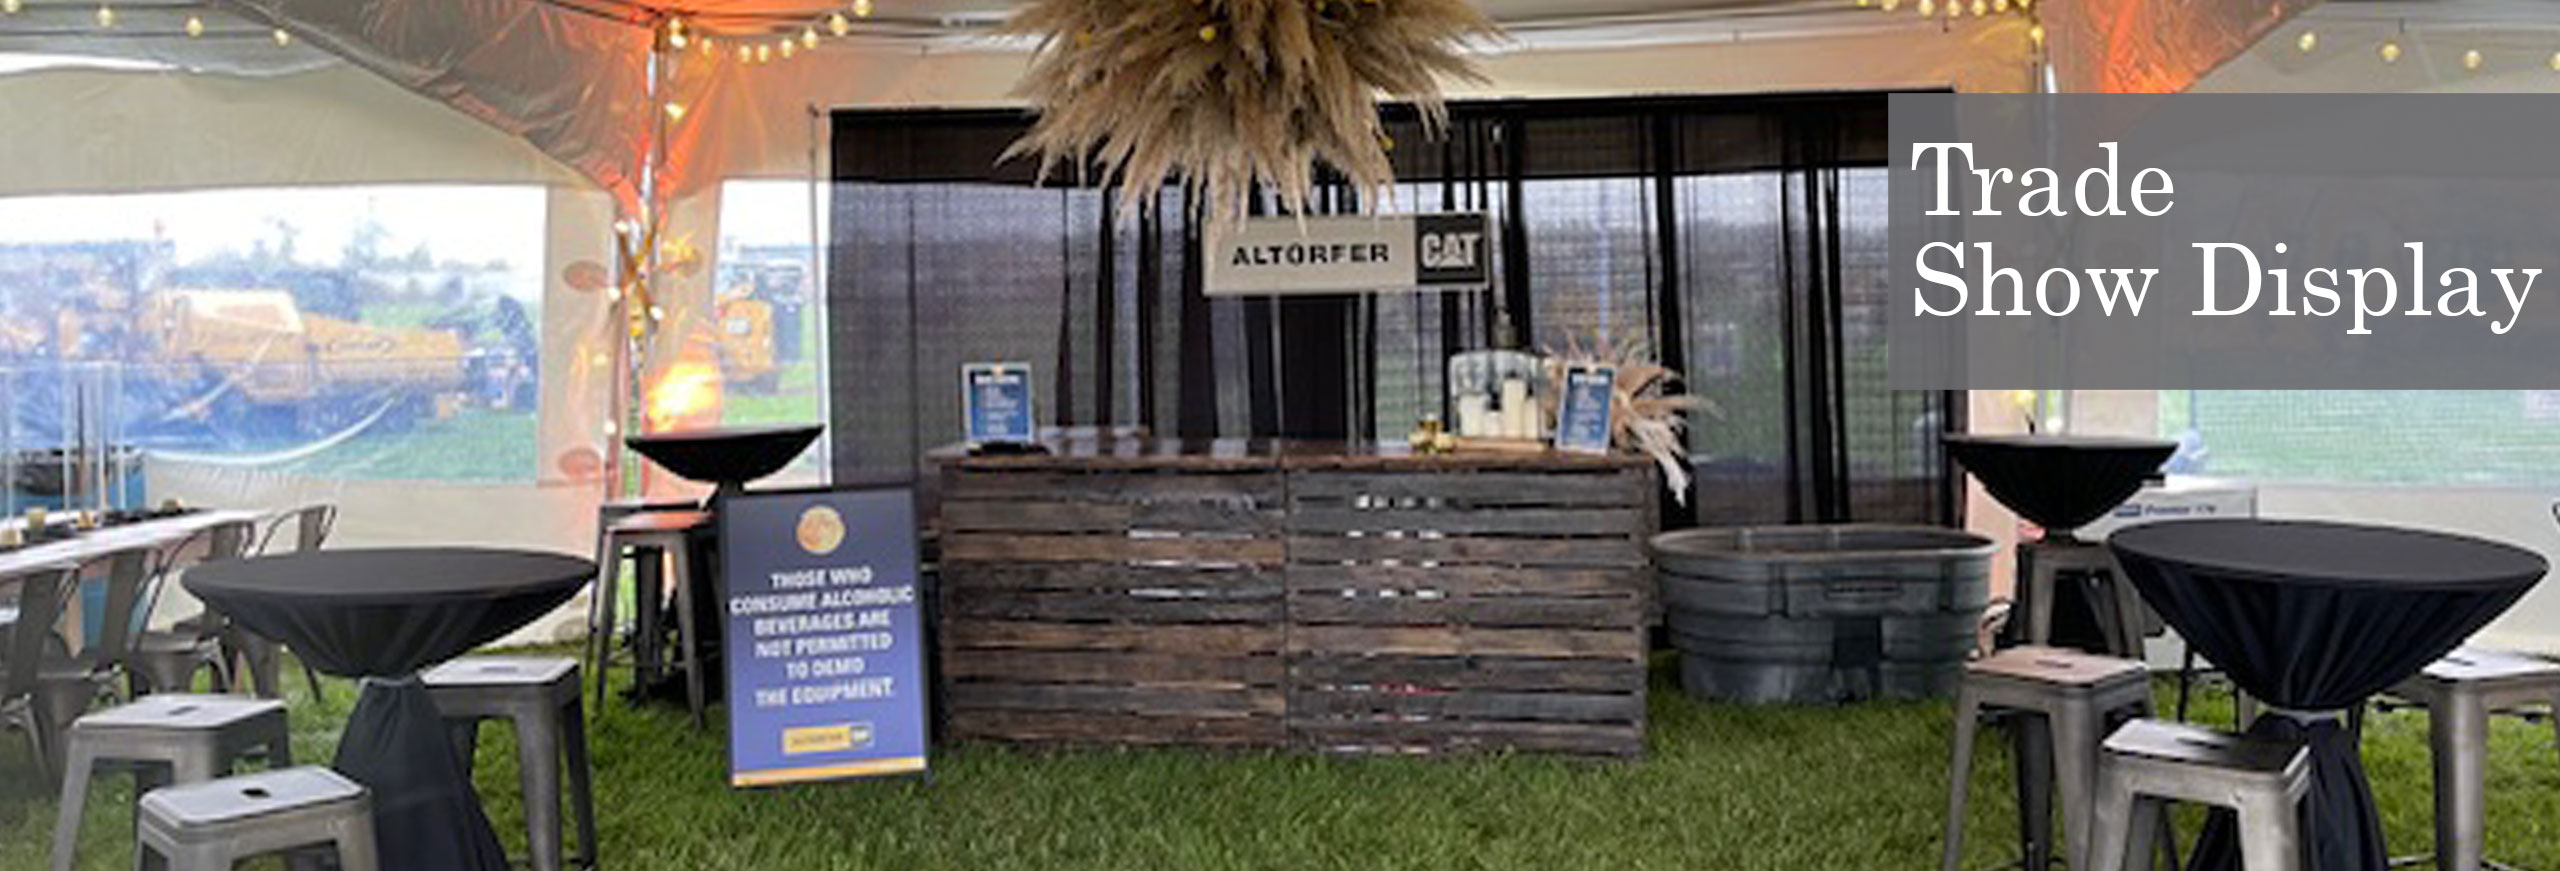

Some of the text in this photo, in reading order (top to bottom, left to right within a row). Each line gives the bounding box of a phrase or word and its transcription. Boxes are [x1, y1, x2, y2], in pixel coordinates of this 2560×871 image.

[1231, 232, 1480, 268] ALTORFER CAT
[771, 566, 873, 588] THOSE WHO
[730, 586, 914, 614] CONSUME ALCOHOLIC
[754, 609, 891, 635] BEVERAGES ARE
[754, 632, 893, 659] NOT PERMITTED
[786, 657, 865, 679] TO DEMO
[755, 688, 787, 707] THE
